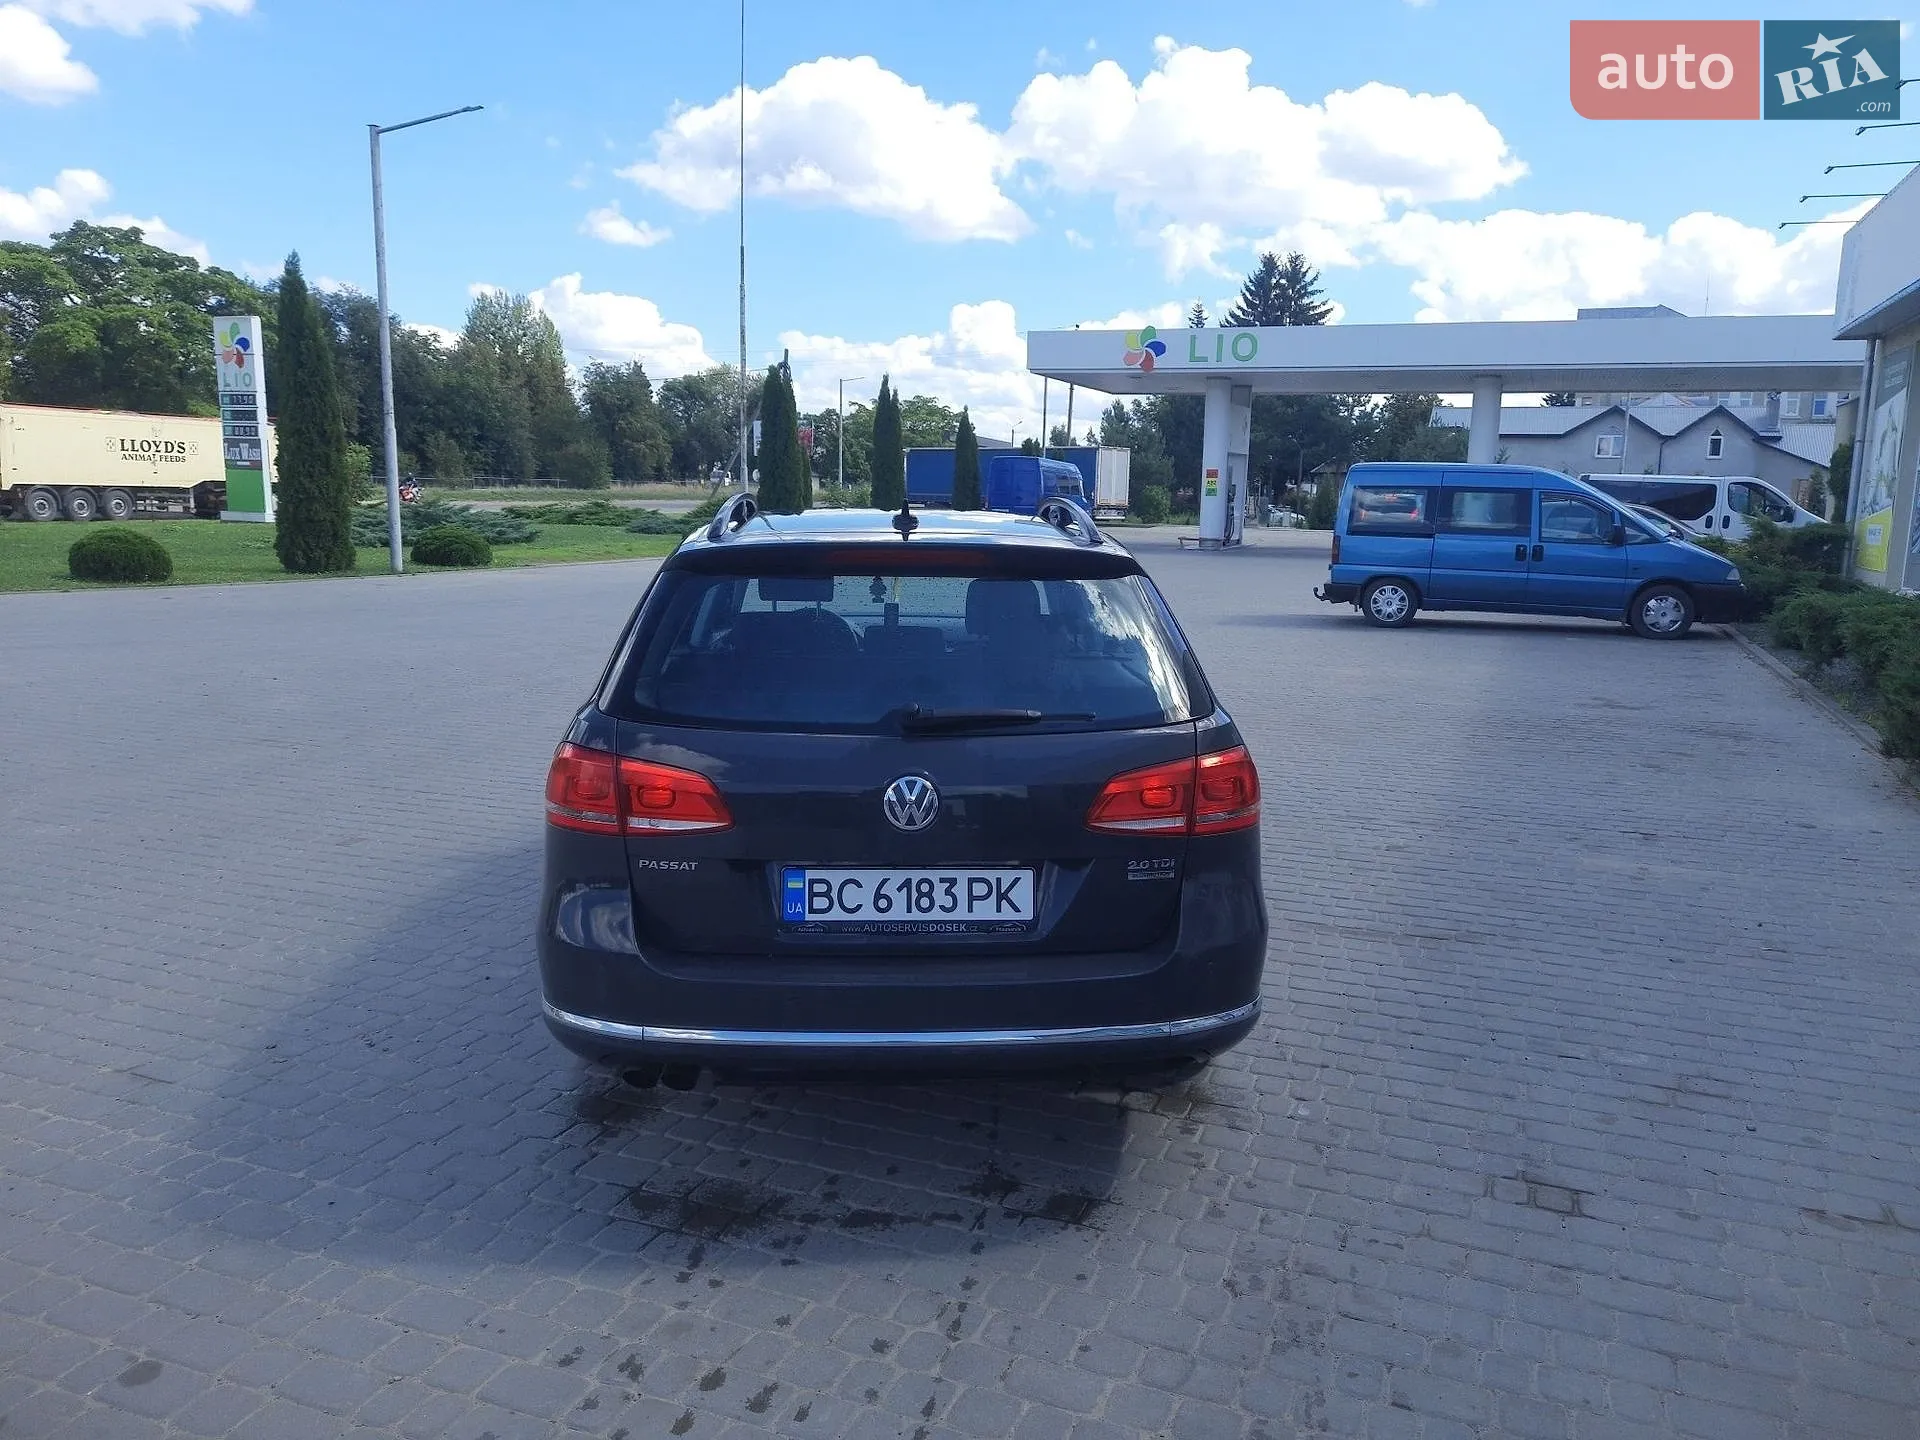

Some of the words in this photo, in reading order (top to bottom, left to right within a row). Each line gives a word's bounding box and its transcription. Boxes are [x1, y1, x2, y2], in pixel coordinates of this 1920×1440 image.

[1188, 332, 1258, 362] LIO
[223, 373, 252, 388] LIO
[120, 438, 186, 454] LLOYD'S
[121, 453, 158, 461] ANIMAL
[159, 454, 186, 462] FEEDS
[639, 859, 699, 871] PASSAT
[1151, 858, 1175, 868] TDI
[807, 877, 864, 915] BC
[873, 877, 958, 914] 6183
[967, 876, 1022, 914] PK
[787, 902, 803, 914] UA
